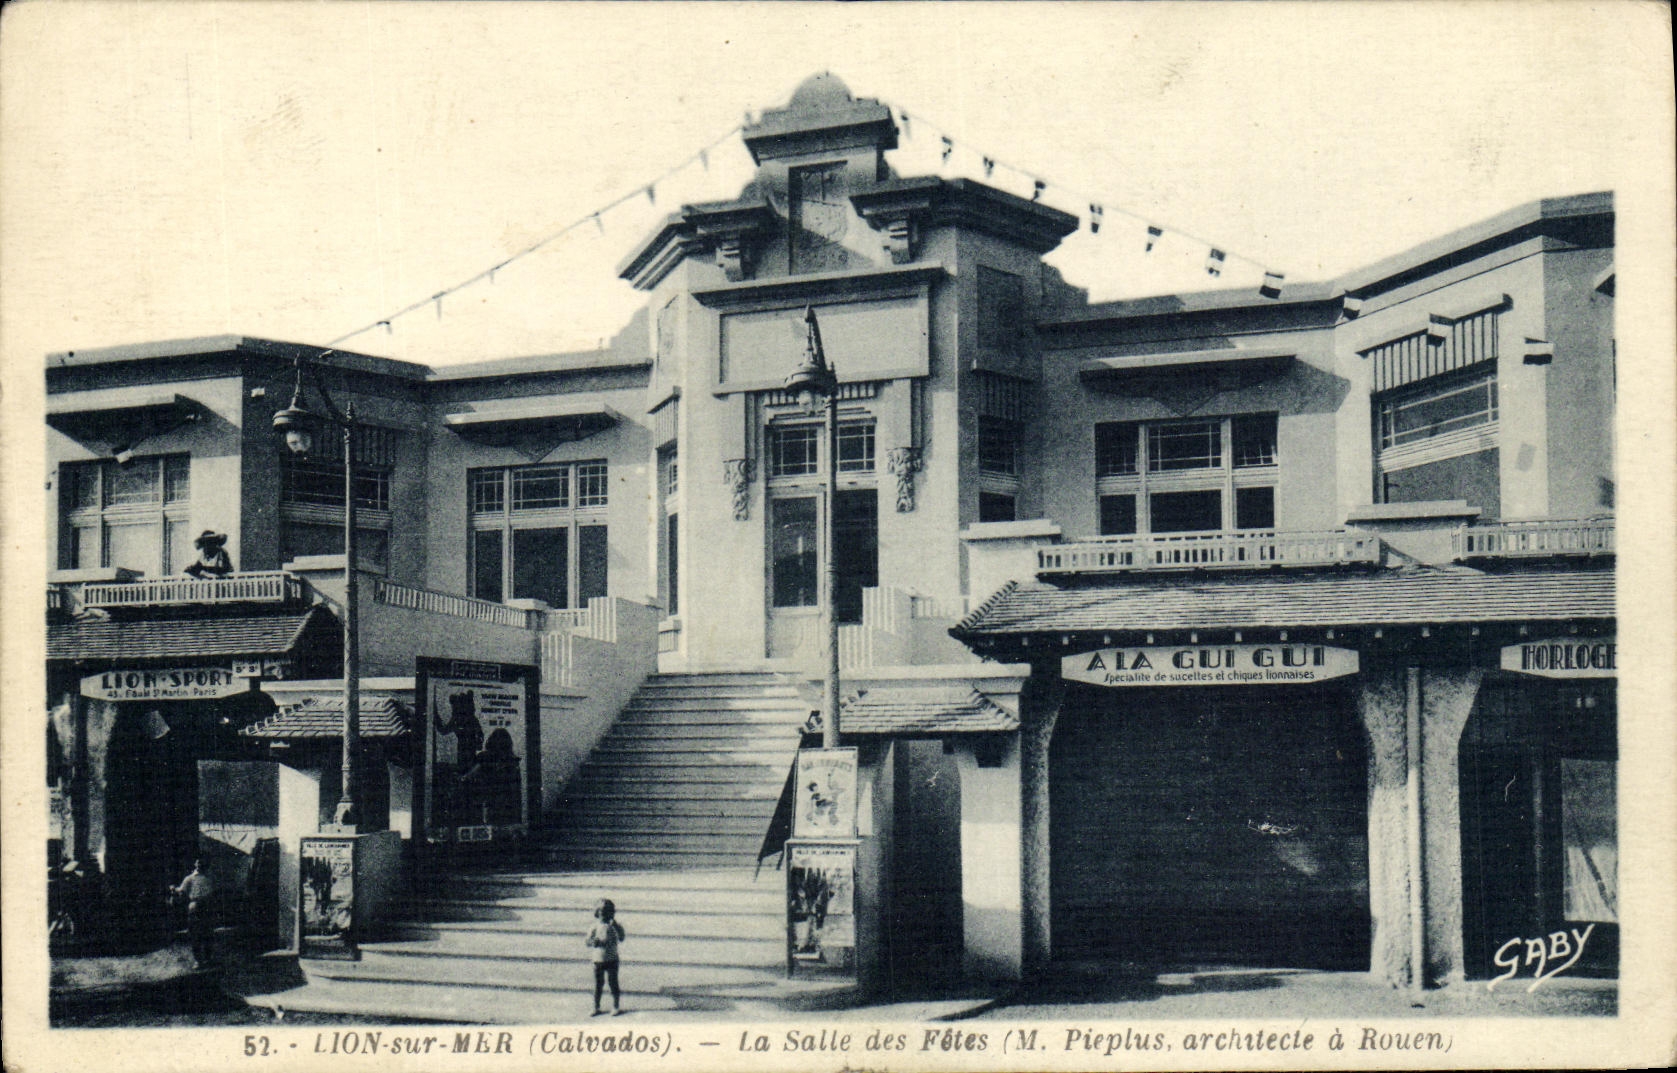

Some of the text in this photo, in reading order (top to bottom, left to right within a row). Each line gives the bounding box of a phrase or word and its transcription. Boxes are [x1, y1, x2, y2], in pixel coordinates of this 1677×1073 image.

[1086, 646, 1325, 671] A LA GUI GUI
[1154, 671, 1168, 681] de
[1170, 671, 1214, 682] sucettes
[1215, 670, 1226, 681] et
[1227, 669, 1263, 682] chiques
[1266, 668, 1316, 681] lionnaises
[193, 687, 217, 697] Paris
